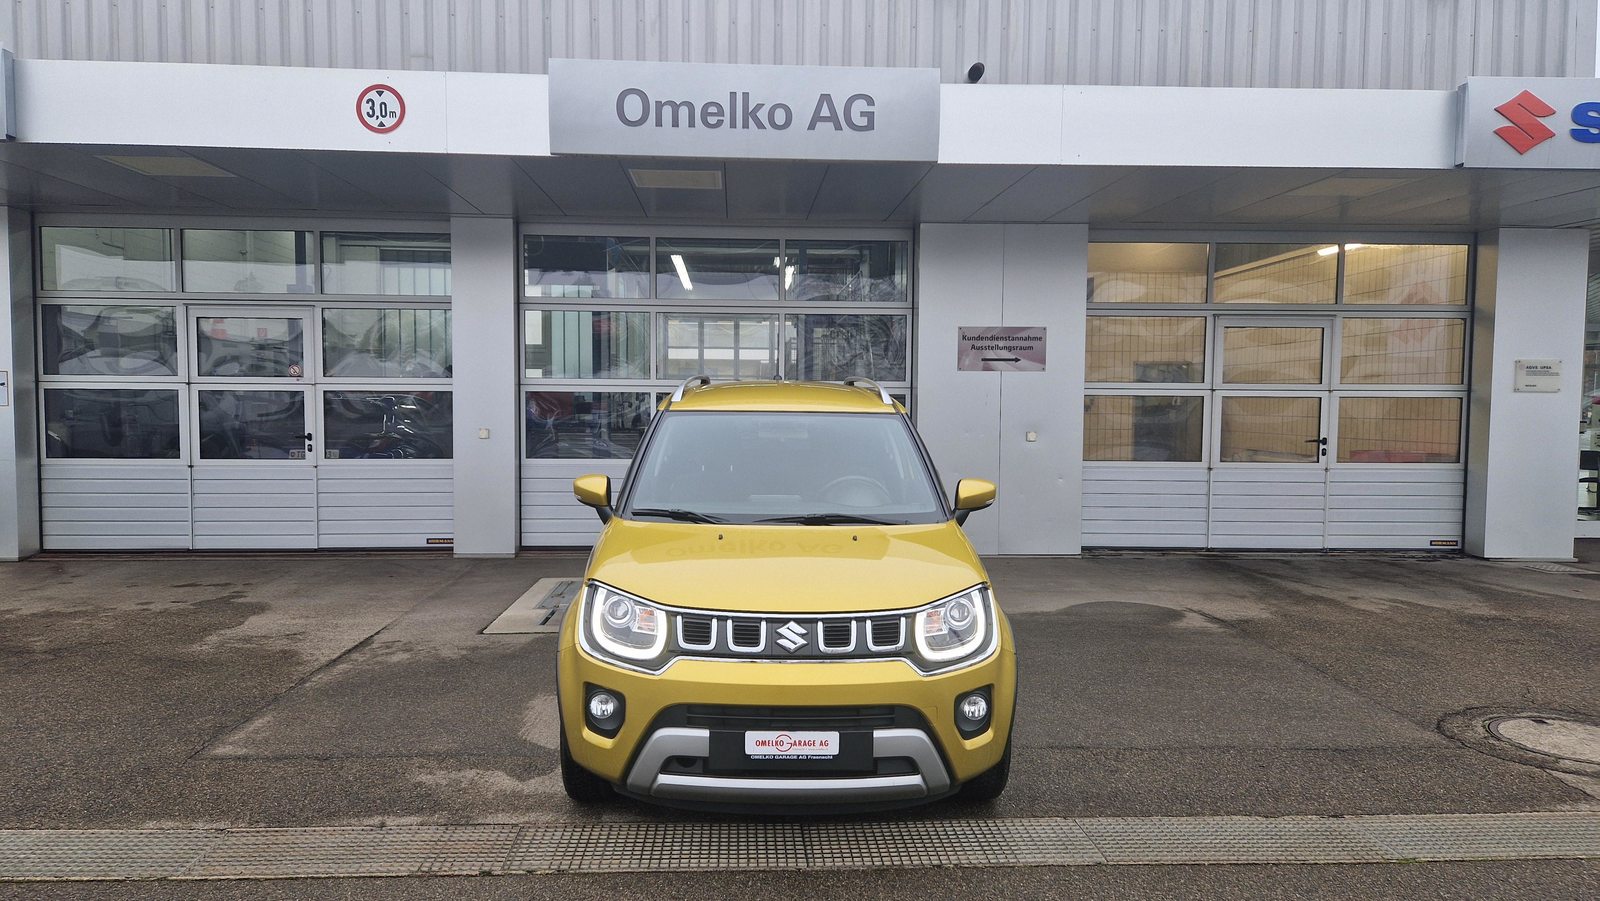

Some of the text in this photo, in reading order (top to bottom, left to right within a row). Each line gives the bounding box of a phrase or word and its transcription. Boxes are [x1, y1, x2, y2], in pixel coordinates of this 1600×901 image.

[616, 87, 876, 132] Omelko AG
[962, 334, 1043, 342] Kundendienstannahme
[970, 344, 1034, 353] Ausstellungsraum
[755, 739, 785, 747] OMELKO
[819, 739, 829, 747] AG
